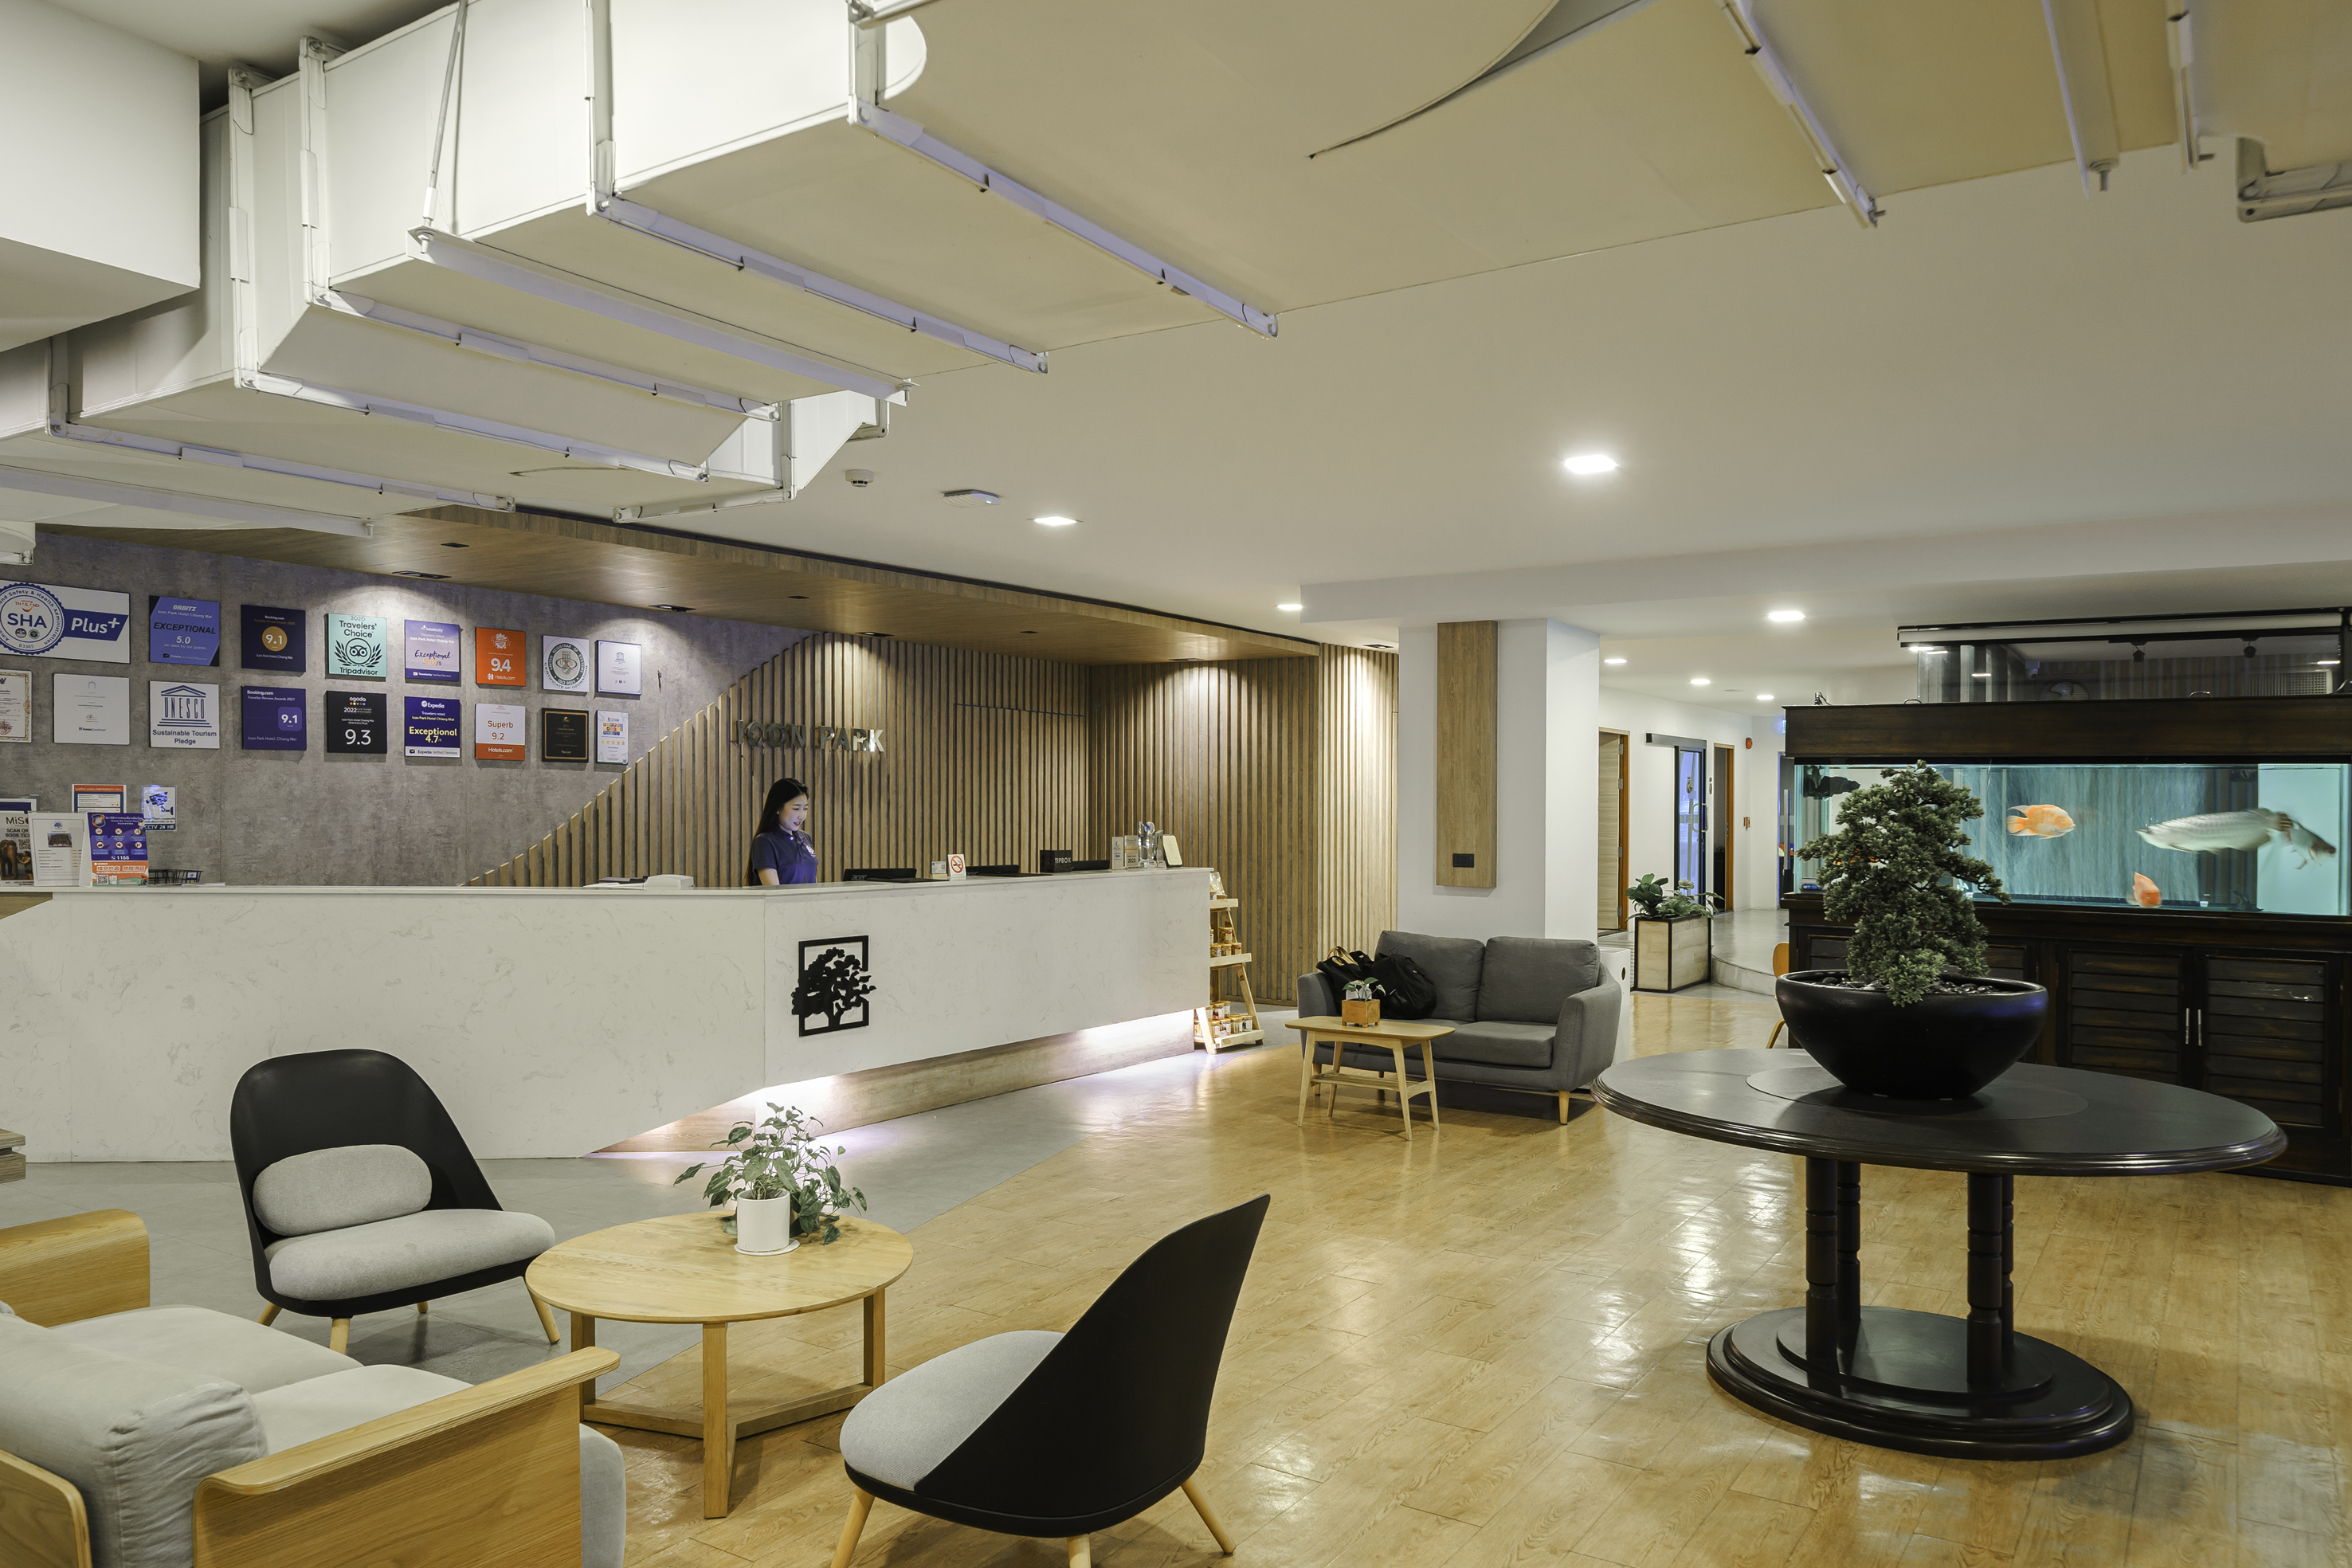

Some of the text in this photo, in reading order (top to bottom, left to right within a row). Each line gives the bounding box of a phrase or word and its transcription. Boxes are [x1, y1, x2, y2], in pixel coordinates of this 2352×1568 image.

[37, 593, 54, 607] Health
[7, 613, 47, 628] SHA
[154, 622, 216, 634] EXCEPTIONAL
[265, 634, 282, 645] 9.1
[415, 649, 451, 660] Exceptional
[491, 657, 512, 672] 9.4
[165, 697, 204, 719] UNESCO
[281, 714, 297, 723] 9.1
[345, 729, 371, 745] 9.3
[409, 726, 457, 736] Exceptional
[736, 719, 884, 751] ICON PARK
